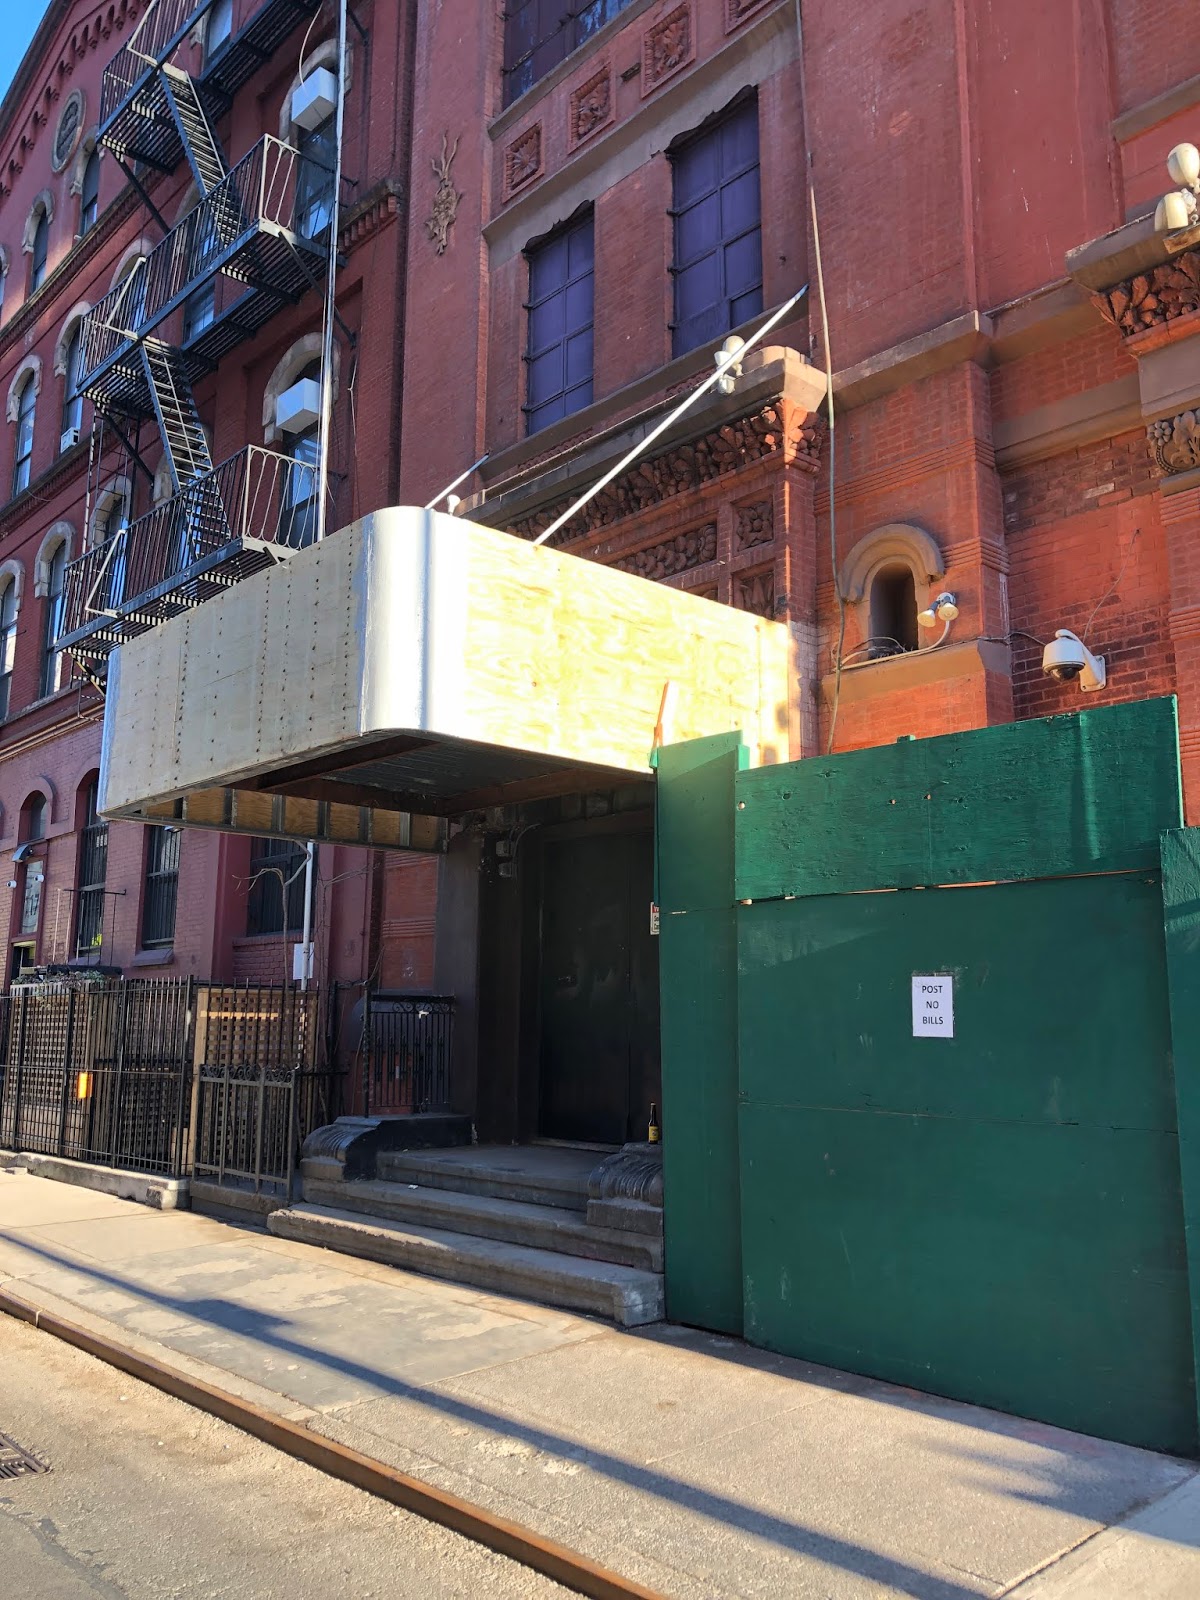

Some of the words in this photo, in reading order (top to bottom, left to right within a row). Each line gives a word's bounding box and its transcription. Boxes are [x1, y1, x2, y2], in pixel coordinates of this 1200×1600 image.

[922, 985, 943, 994] POST
[926, 1001, 939, 1009] NO
[922, 1016, 944, 1025] BILLS
